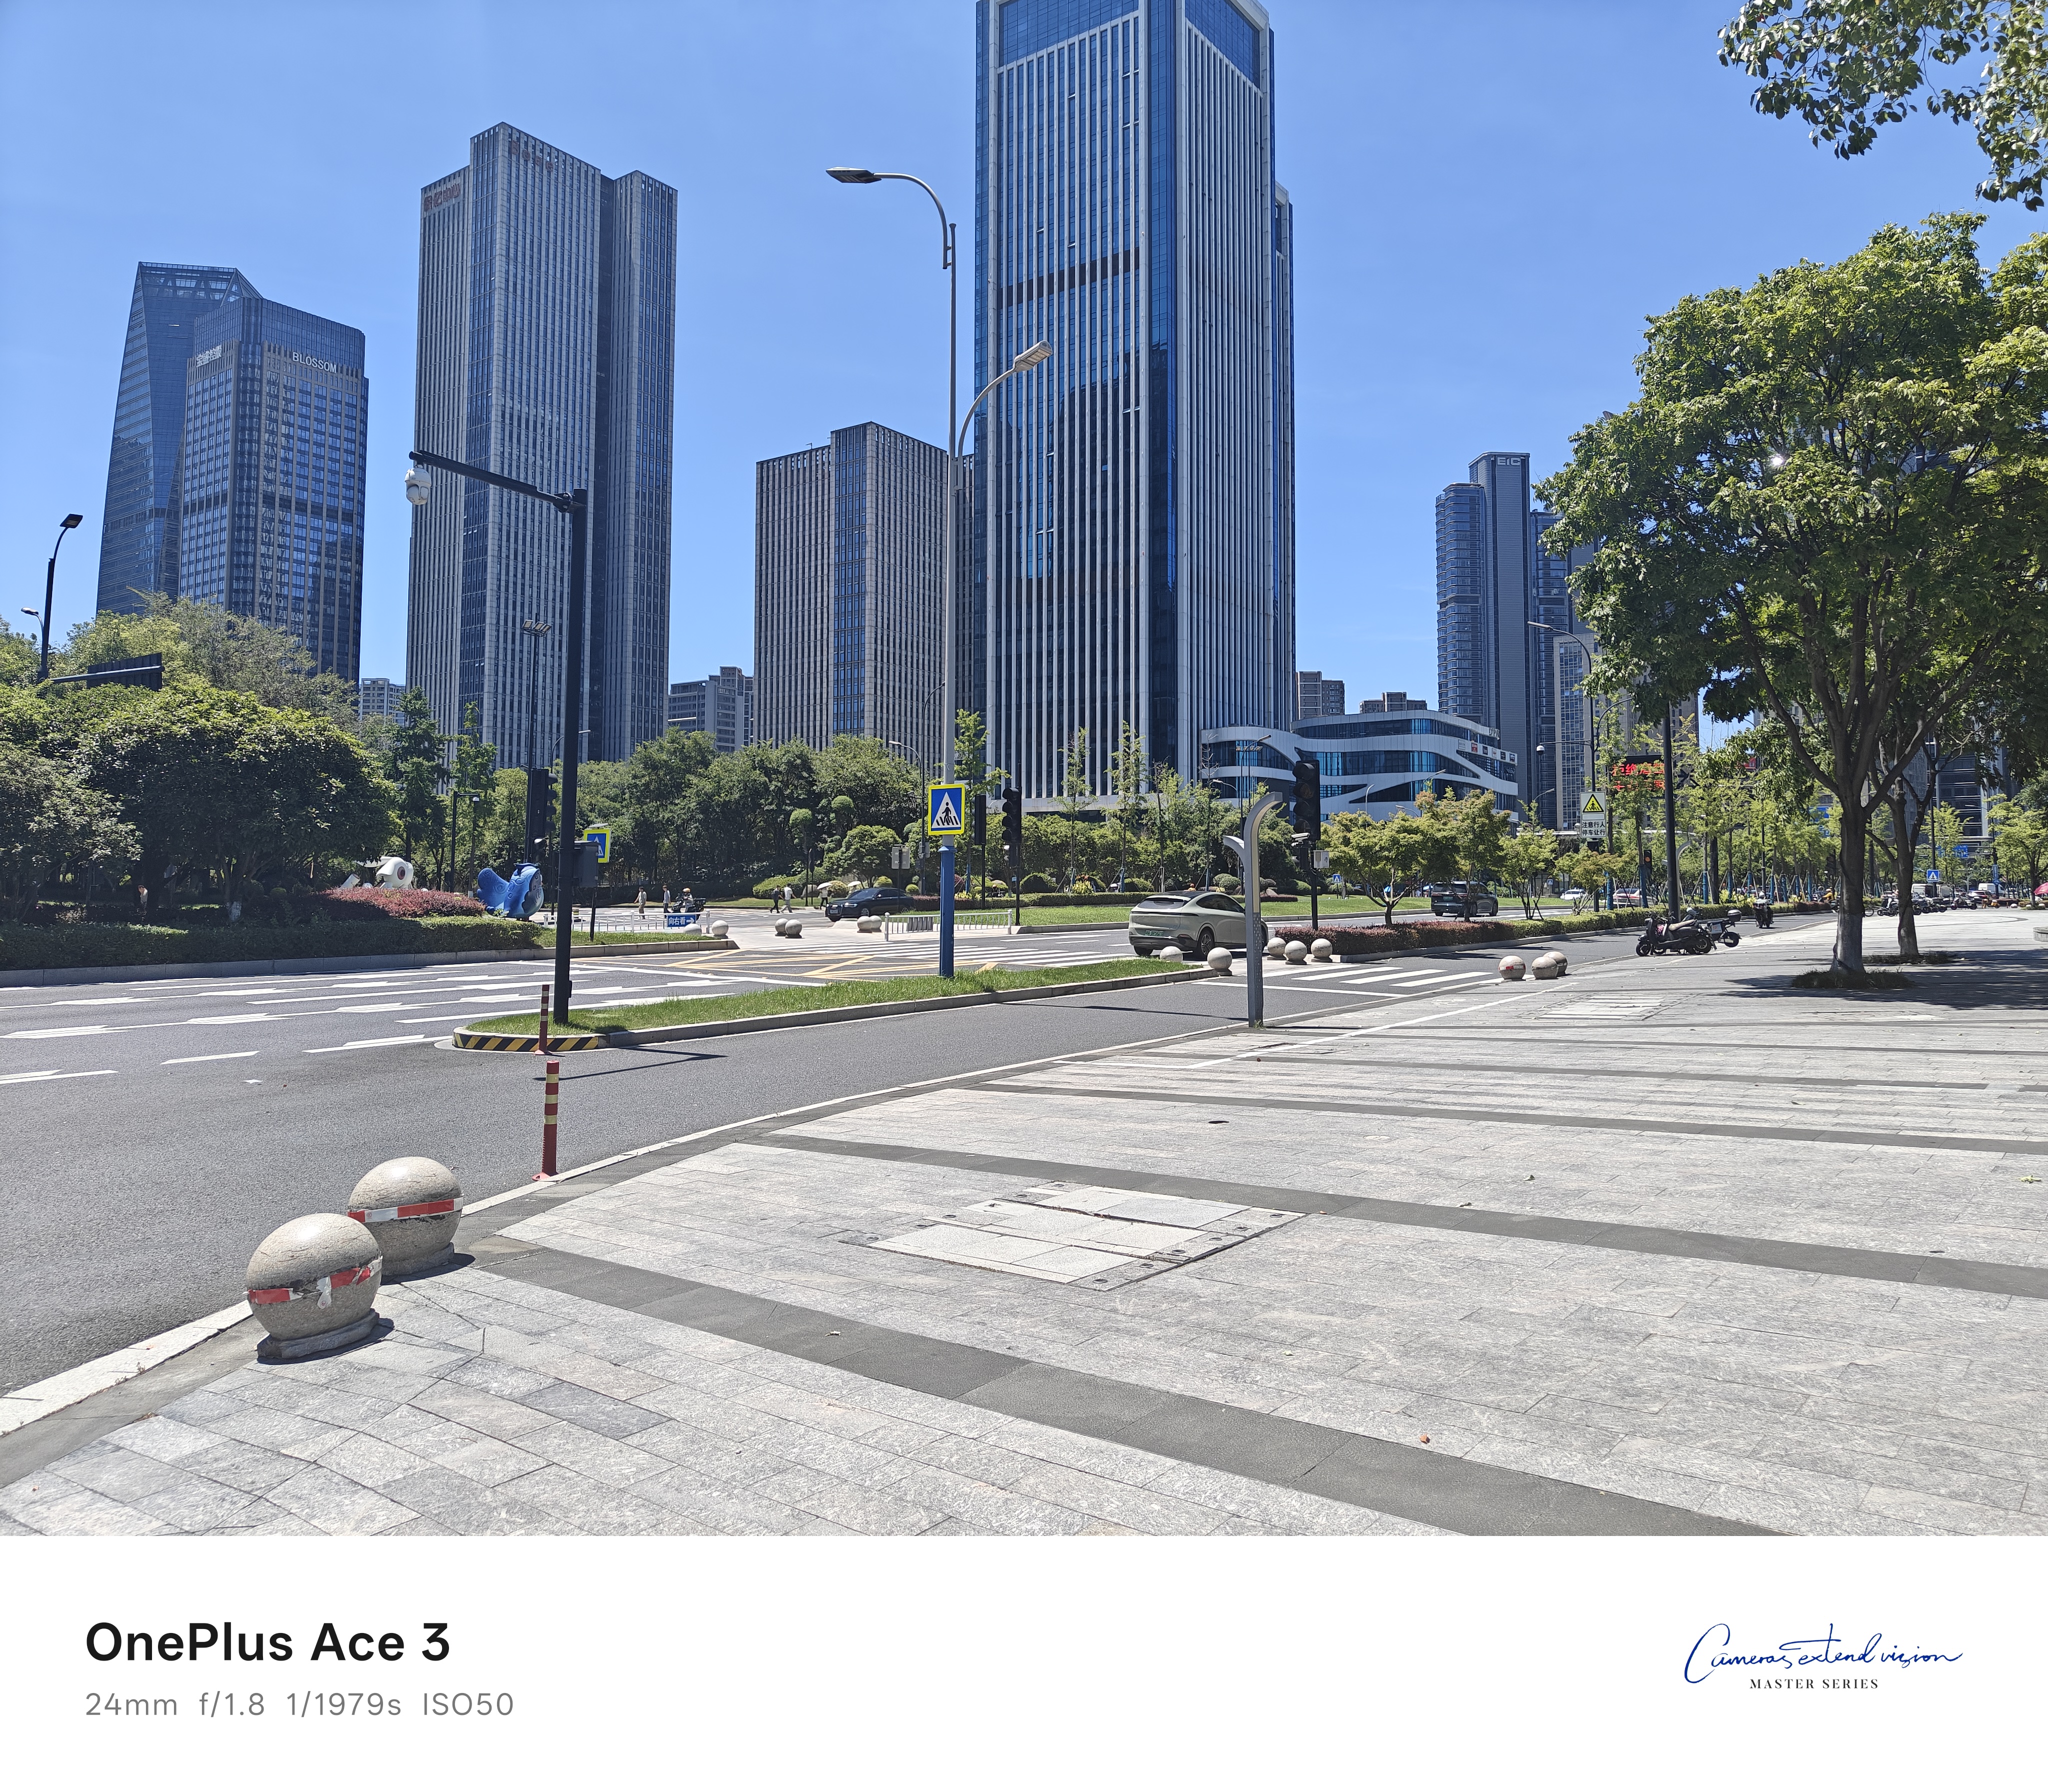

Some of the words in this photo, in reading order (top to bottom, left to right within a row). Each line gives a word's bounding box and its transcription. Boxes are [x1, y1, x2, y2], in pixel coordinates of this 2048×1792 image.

[292, 352, 336, 374] BLOSSOM
[1497, 457, 1520, 466] EIC
[668, 916, 686, 925] 向右看
